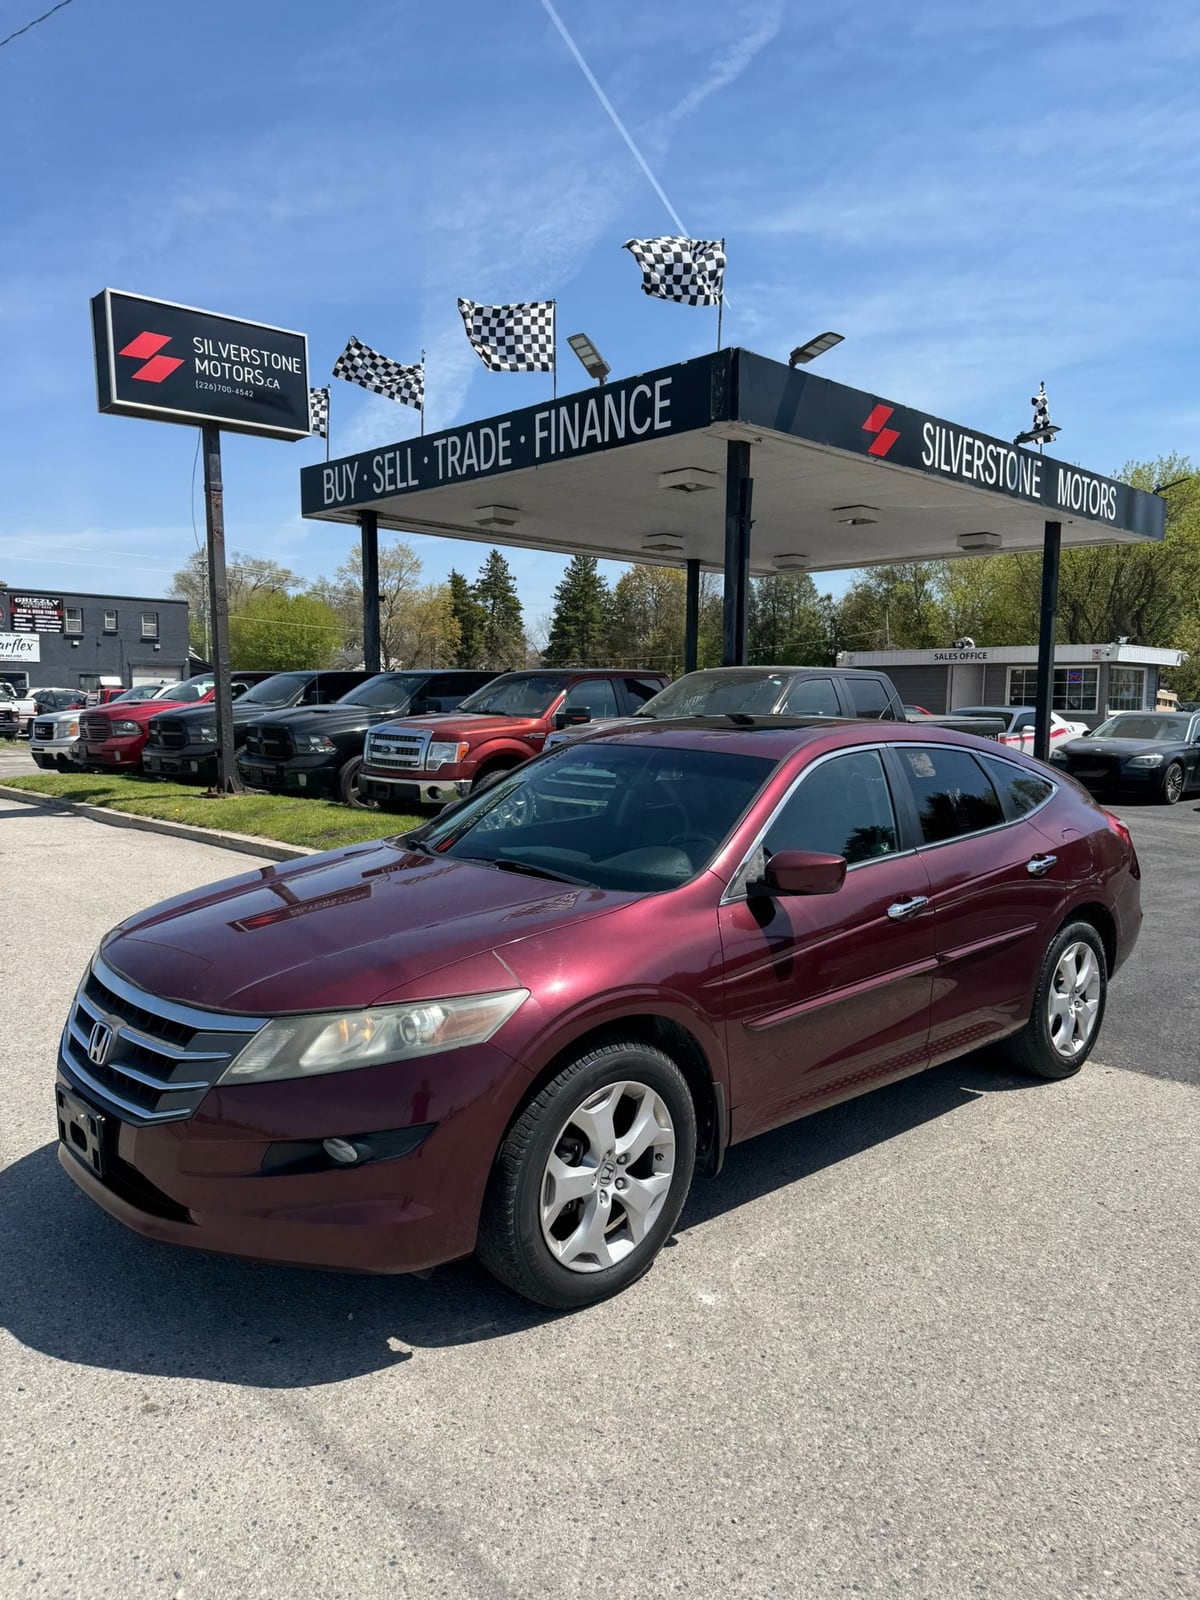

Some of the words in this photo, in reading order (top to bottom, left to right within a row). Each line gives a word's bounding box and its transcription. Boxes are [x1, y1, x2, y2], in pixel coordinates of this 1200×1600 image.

[192, 336, 302, 375] SILVERSTONE
[194, 357, 281, 390] MOTORS.CA
[195, 380, 254, 398] (226)700-4542
[322, 461, 359, 505] BUY
[372, 448, 419, 494] SELL
[433, 421, 512, 480] TRADE
[534, 376, 673, 458] FINANCE
[921, 422, 1043, 498] SILVERSTONE
[1057, 467, 1117, 521] MOTORS
[14, 597, 60, 606] GRIZZLY
[934, 652, 958, 661] SALES
[959, 651, 988, 660] OFFICE
